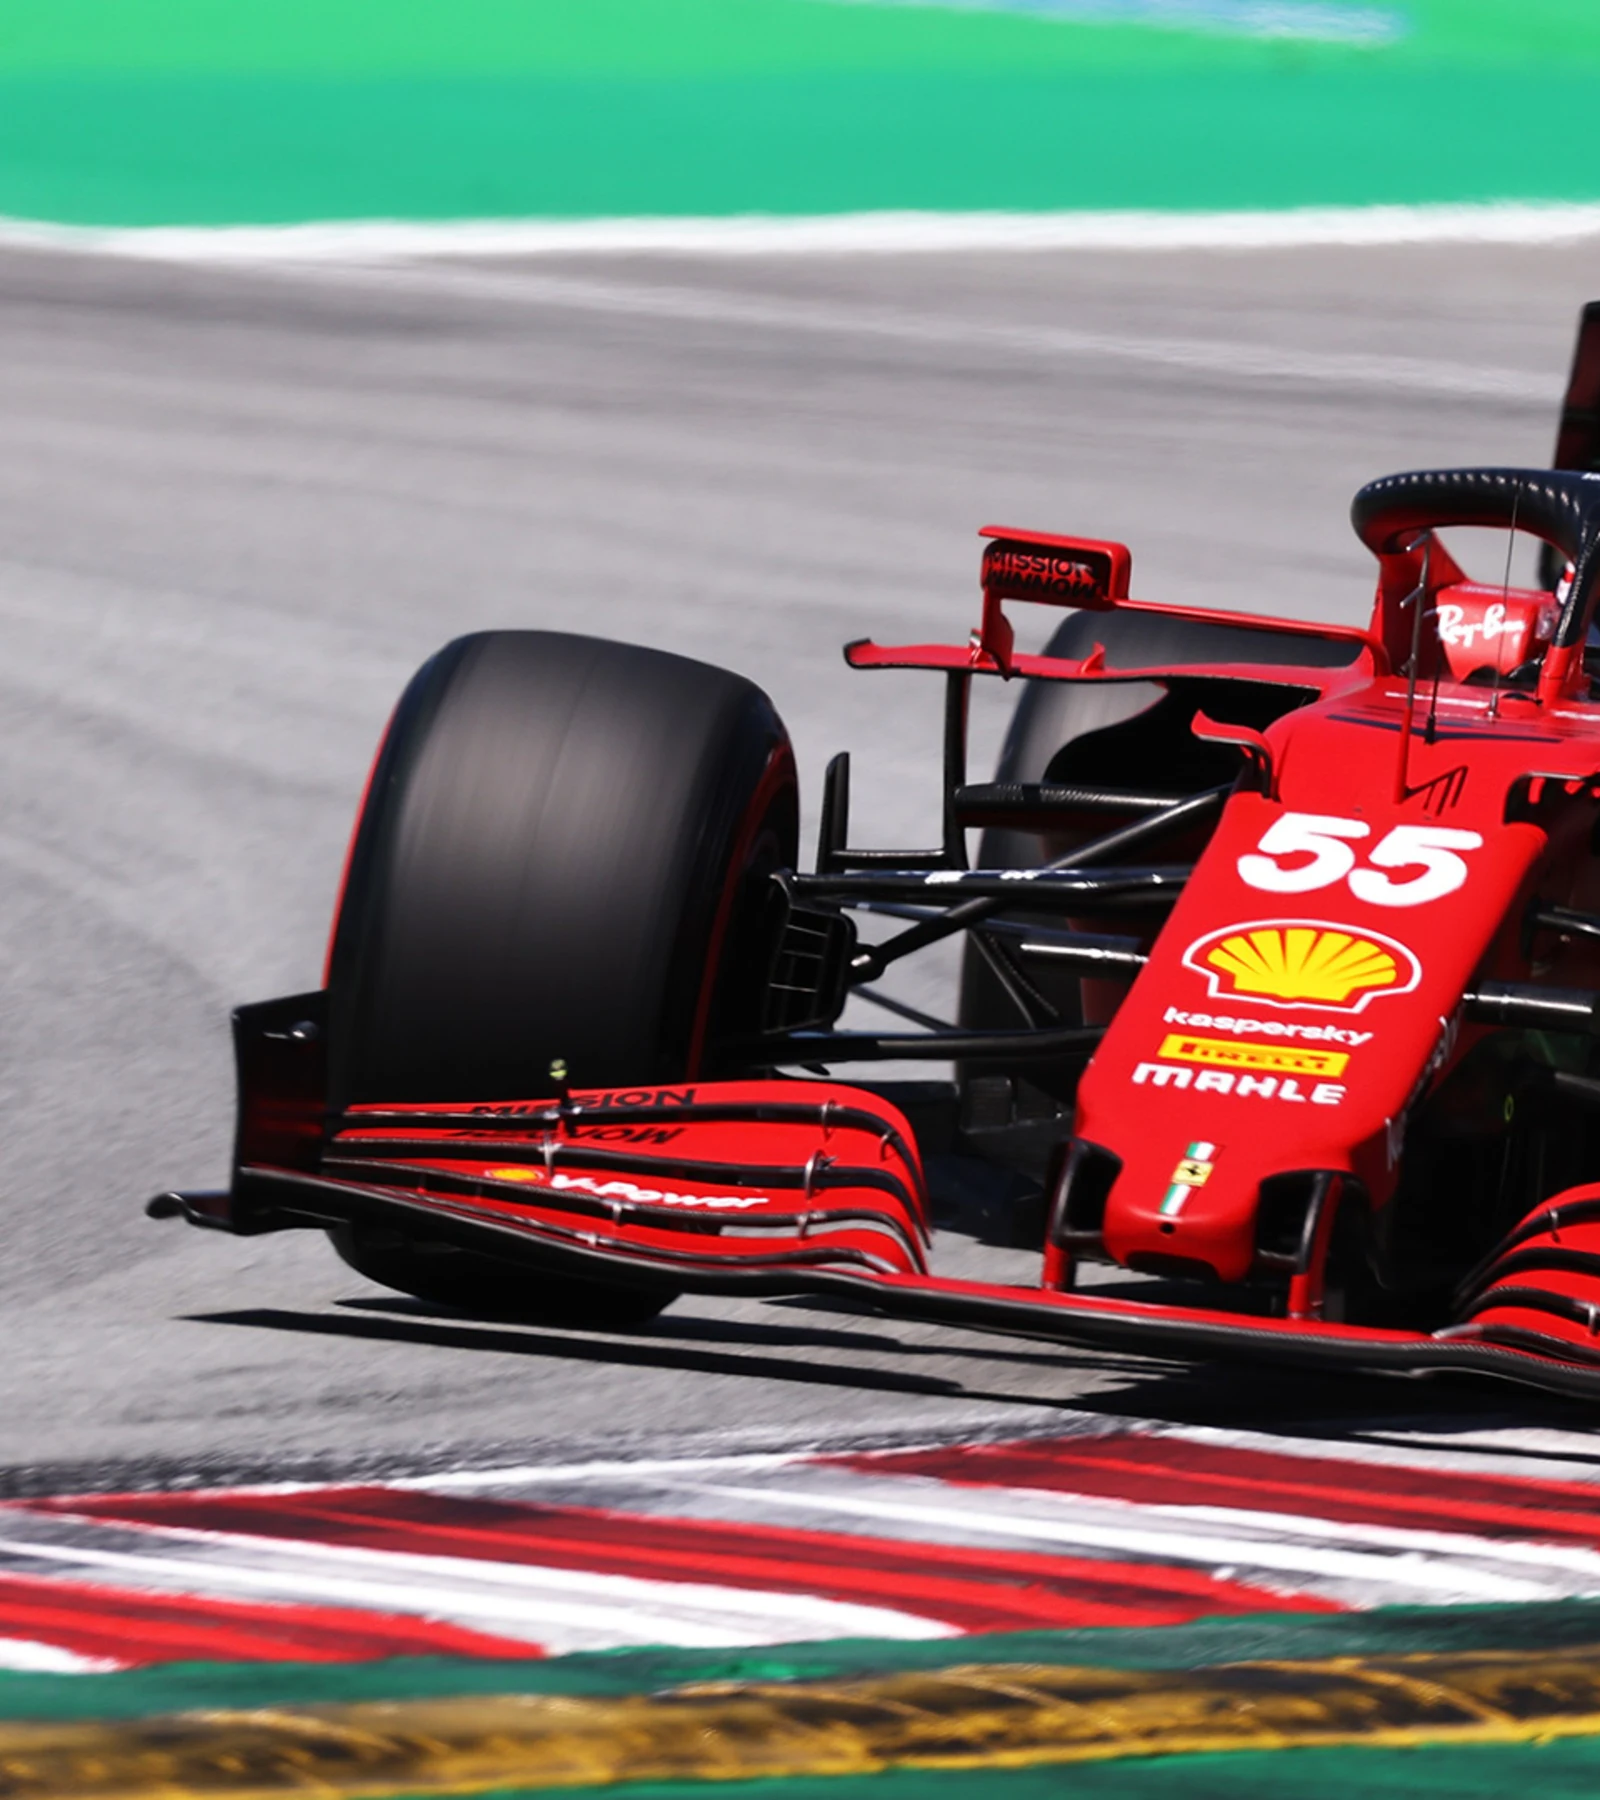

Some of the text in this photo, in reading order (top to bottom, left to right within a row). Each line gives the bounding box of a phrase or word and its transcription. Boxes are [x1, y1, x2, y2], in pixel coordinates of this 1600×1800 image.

[1436, 603, 1526, 647] Ray-Ban
[1237, 811, 1483, 907] 55
[1163, 1006, 1374, 1046] kaspersky
[1177, 1041, 1332, 1071] PIRELLI
[1131, 1062, 1348, 1105] MAHLE
[551, 1174, 770, 1208] V-Power
